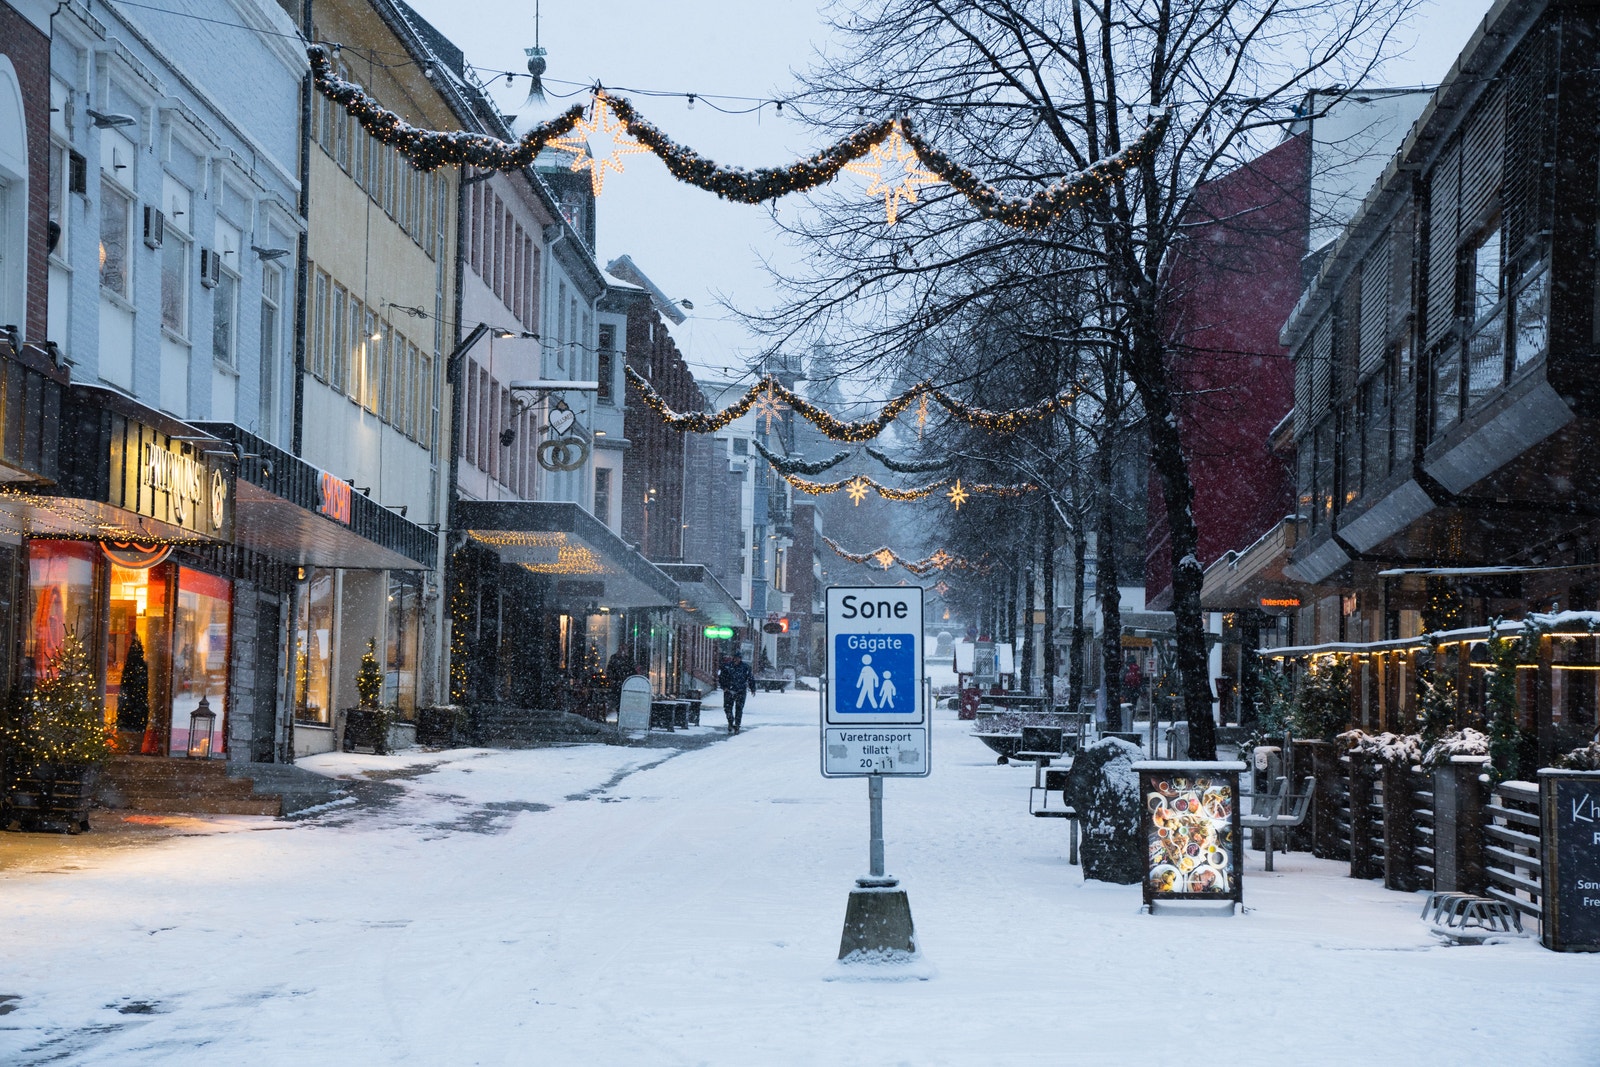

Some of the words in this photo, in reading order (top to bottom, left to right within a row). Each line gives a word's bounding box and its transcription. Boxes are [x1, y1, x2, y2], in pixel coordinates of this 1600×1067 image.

[841, 595, 908, 619] Sone
[848, 635, 902, 653] Gågate
[840, 732, 911, 743] Varetransport
[862, 745, 889, 755] tillatt
